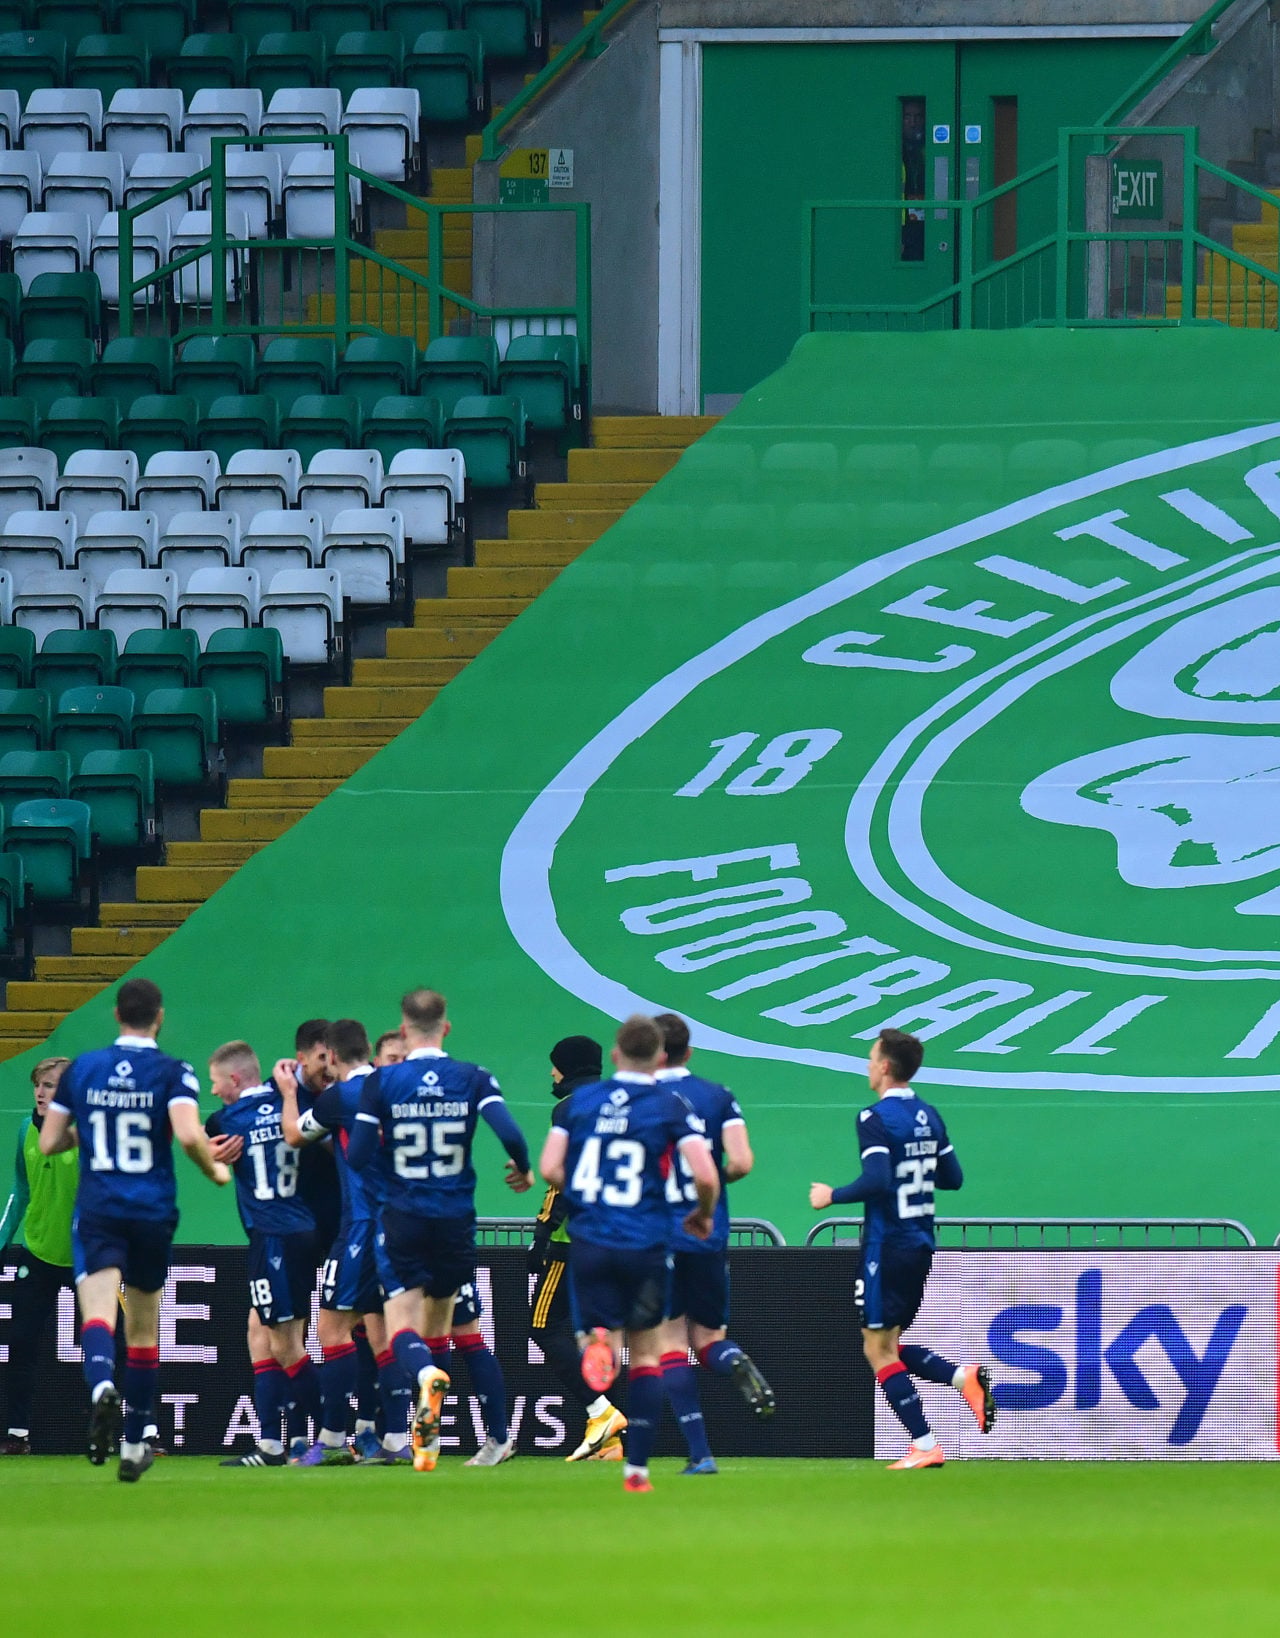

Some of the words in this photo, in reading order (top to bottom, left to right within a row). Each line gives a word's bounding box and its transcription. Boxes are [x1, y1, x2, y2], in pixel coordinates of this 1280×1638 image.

[529, 153, 547, 174] 137
[1118, 171, 1158, 206] EXIT
[673, 728, 842, 797] 18
[604, 843, 1168, 1056] FOOTBALL
[249, 1127, 284, 1144] KELL
[391, 1101, 469, 1118] DONALDSON
[88, 1110, 153, 1173] 16
[247, 1141, 300, 1200] 18
[393, 1121, 466, 1179] 25
[571, 1137, 645, 1208] 43
[987, 1268, 1248, 1446] sky
